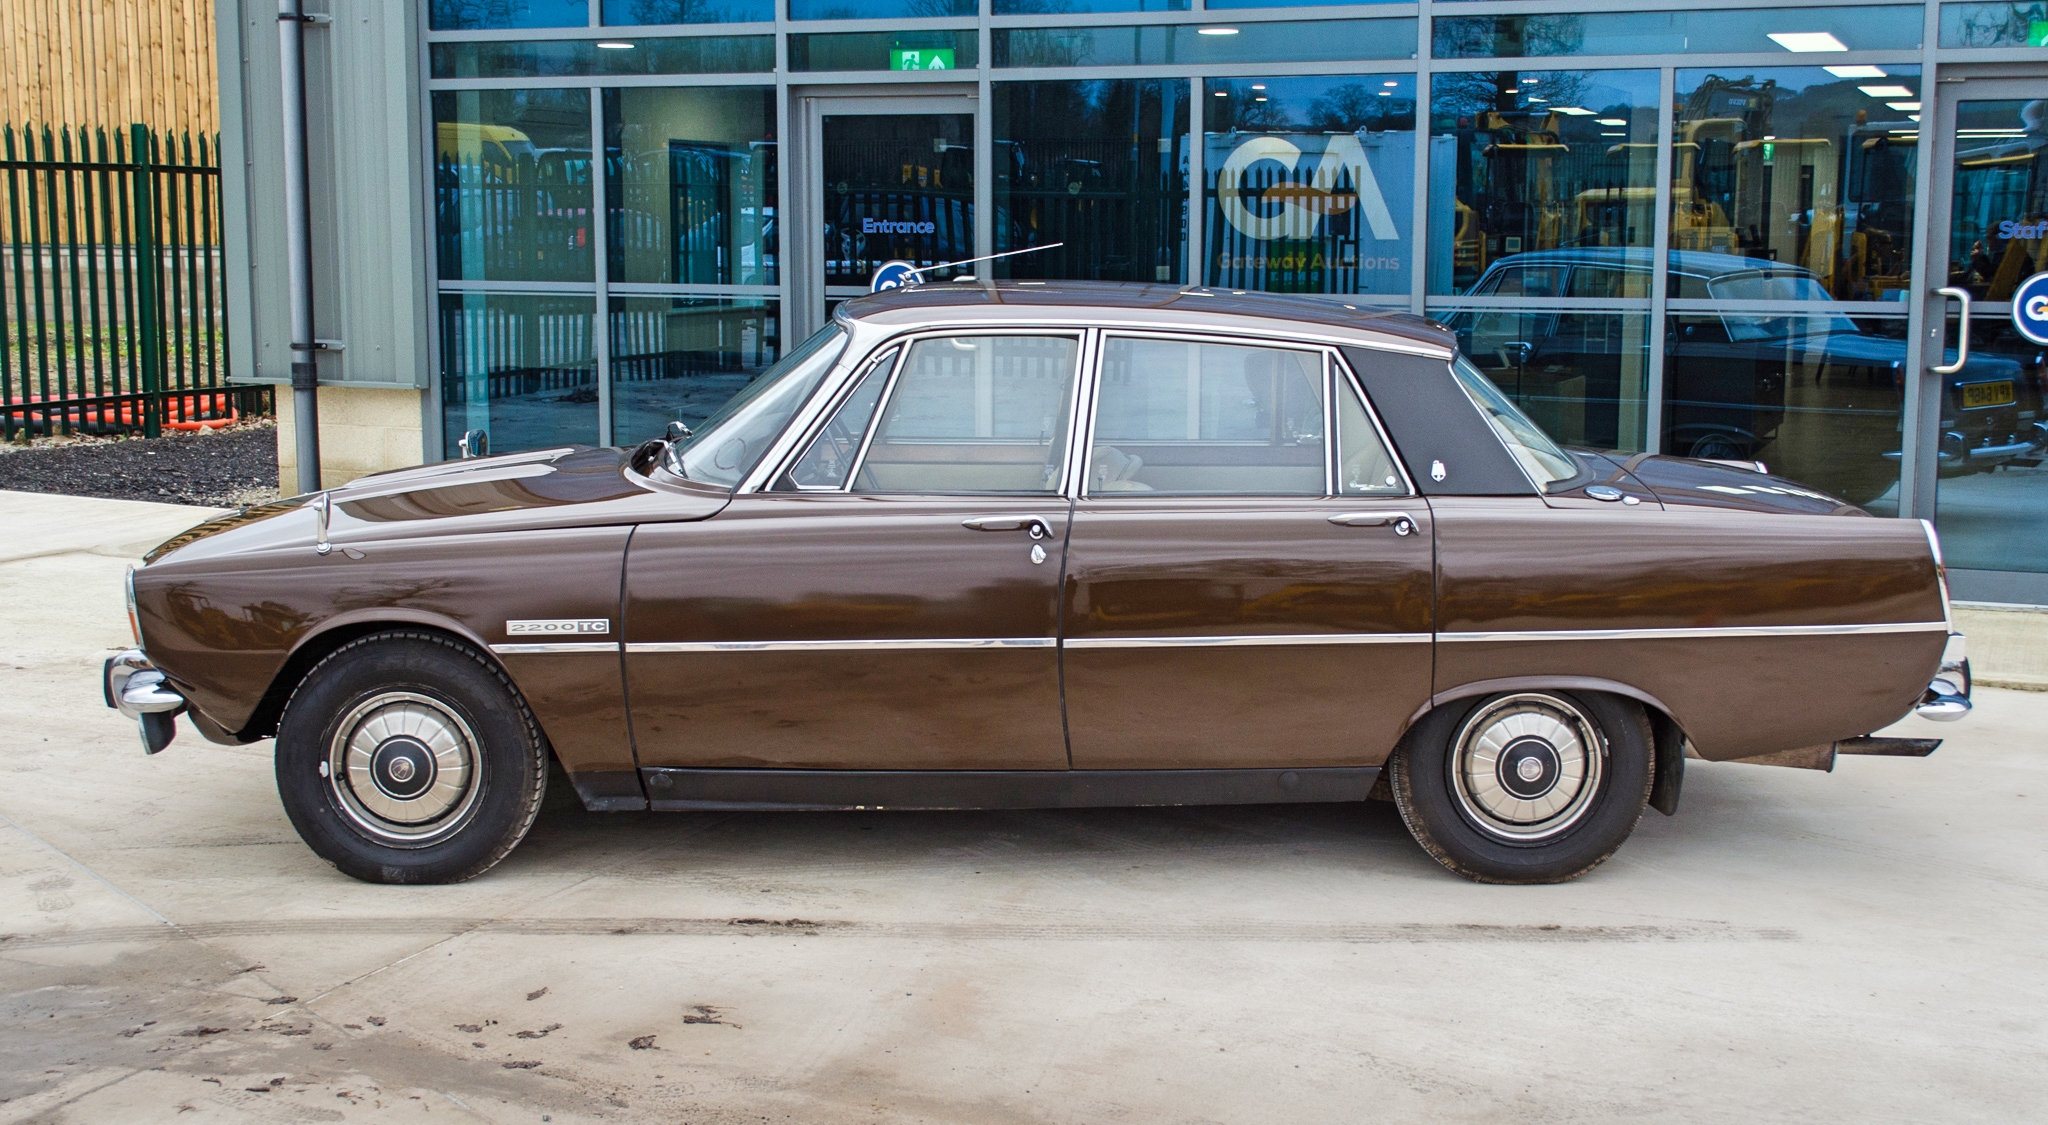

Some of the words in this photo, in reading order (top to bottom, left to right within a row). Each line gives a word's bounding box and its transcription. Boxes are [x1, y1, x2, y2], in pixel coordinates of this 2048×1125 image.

[1217, 135, 1400, 241] GA
[862, 217, 935, 234] Entrance
[1998, 220, 2048, 239] Staf
[1217, 253, 1307, 272] Gateway
[1310, 253, 1400, 270] Auctions
